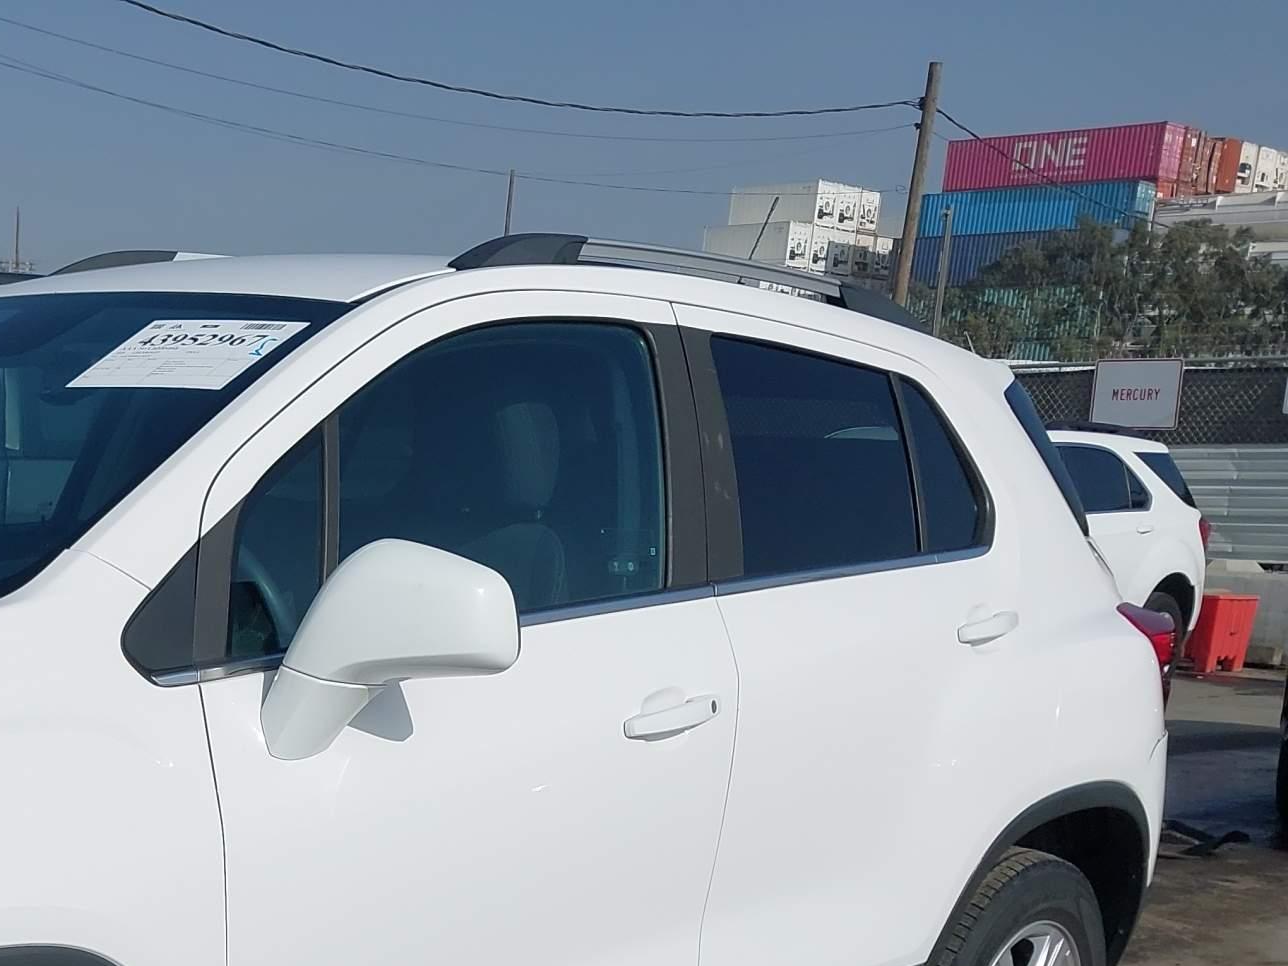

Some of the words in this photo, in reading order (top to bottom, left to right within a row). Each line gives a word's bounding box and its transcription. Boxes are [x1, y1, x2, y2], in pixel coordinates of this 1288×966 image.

[1012, 137, 1087, 170] ONE
[139, 333, 269, 347] 43952967
[1111, 388, 1160, 401] MERCURY
